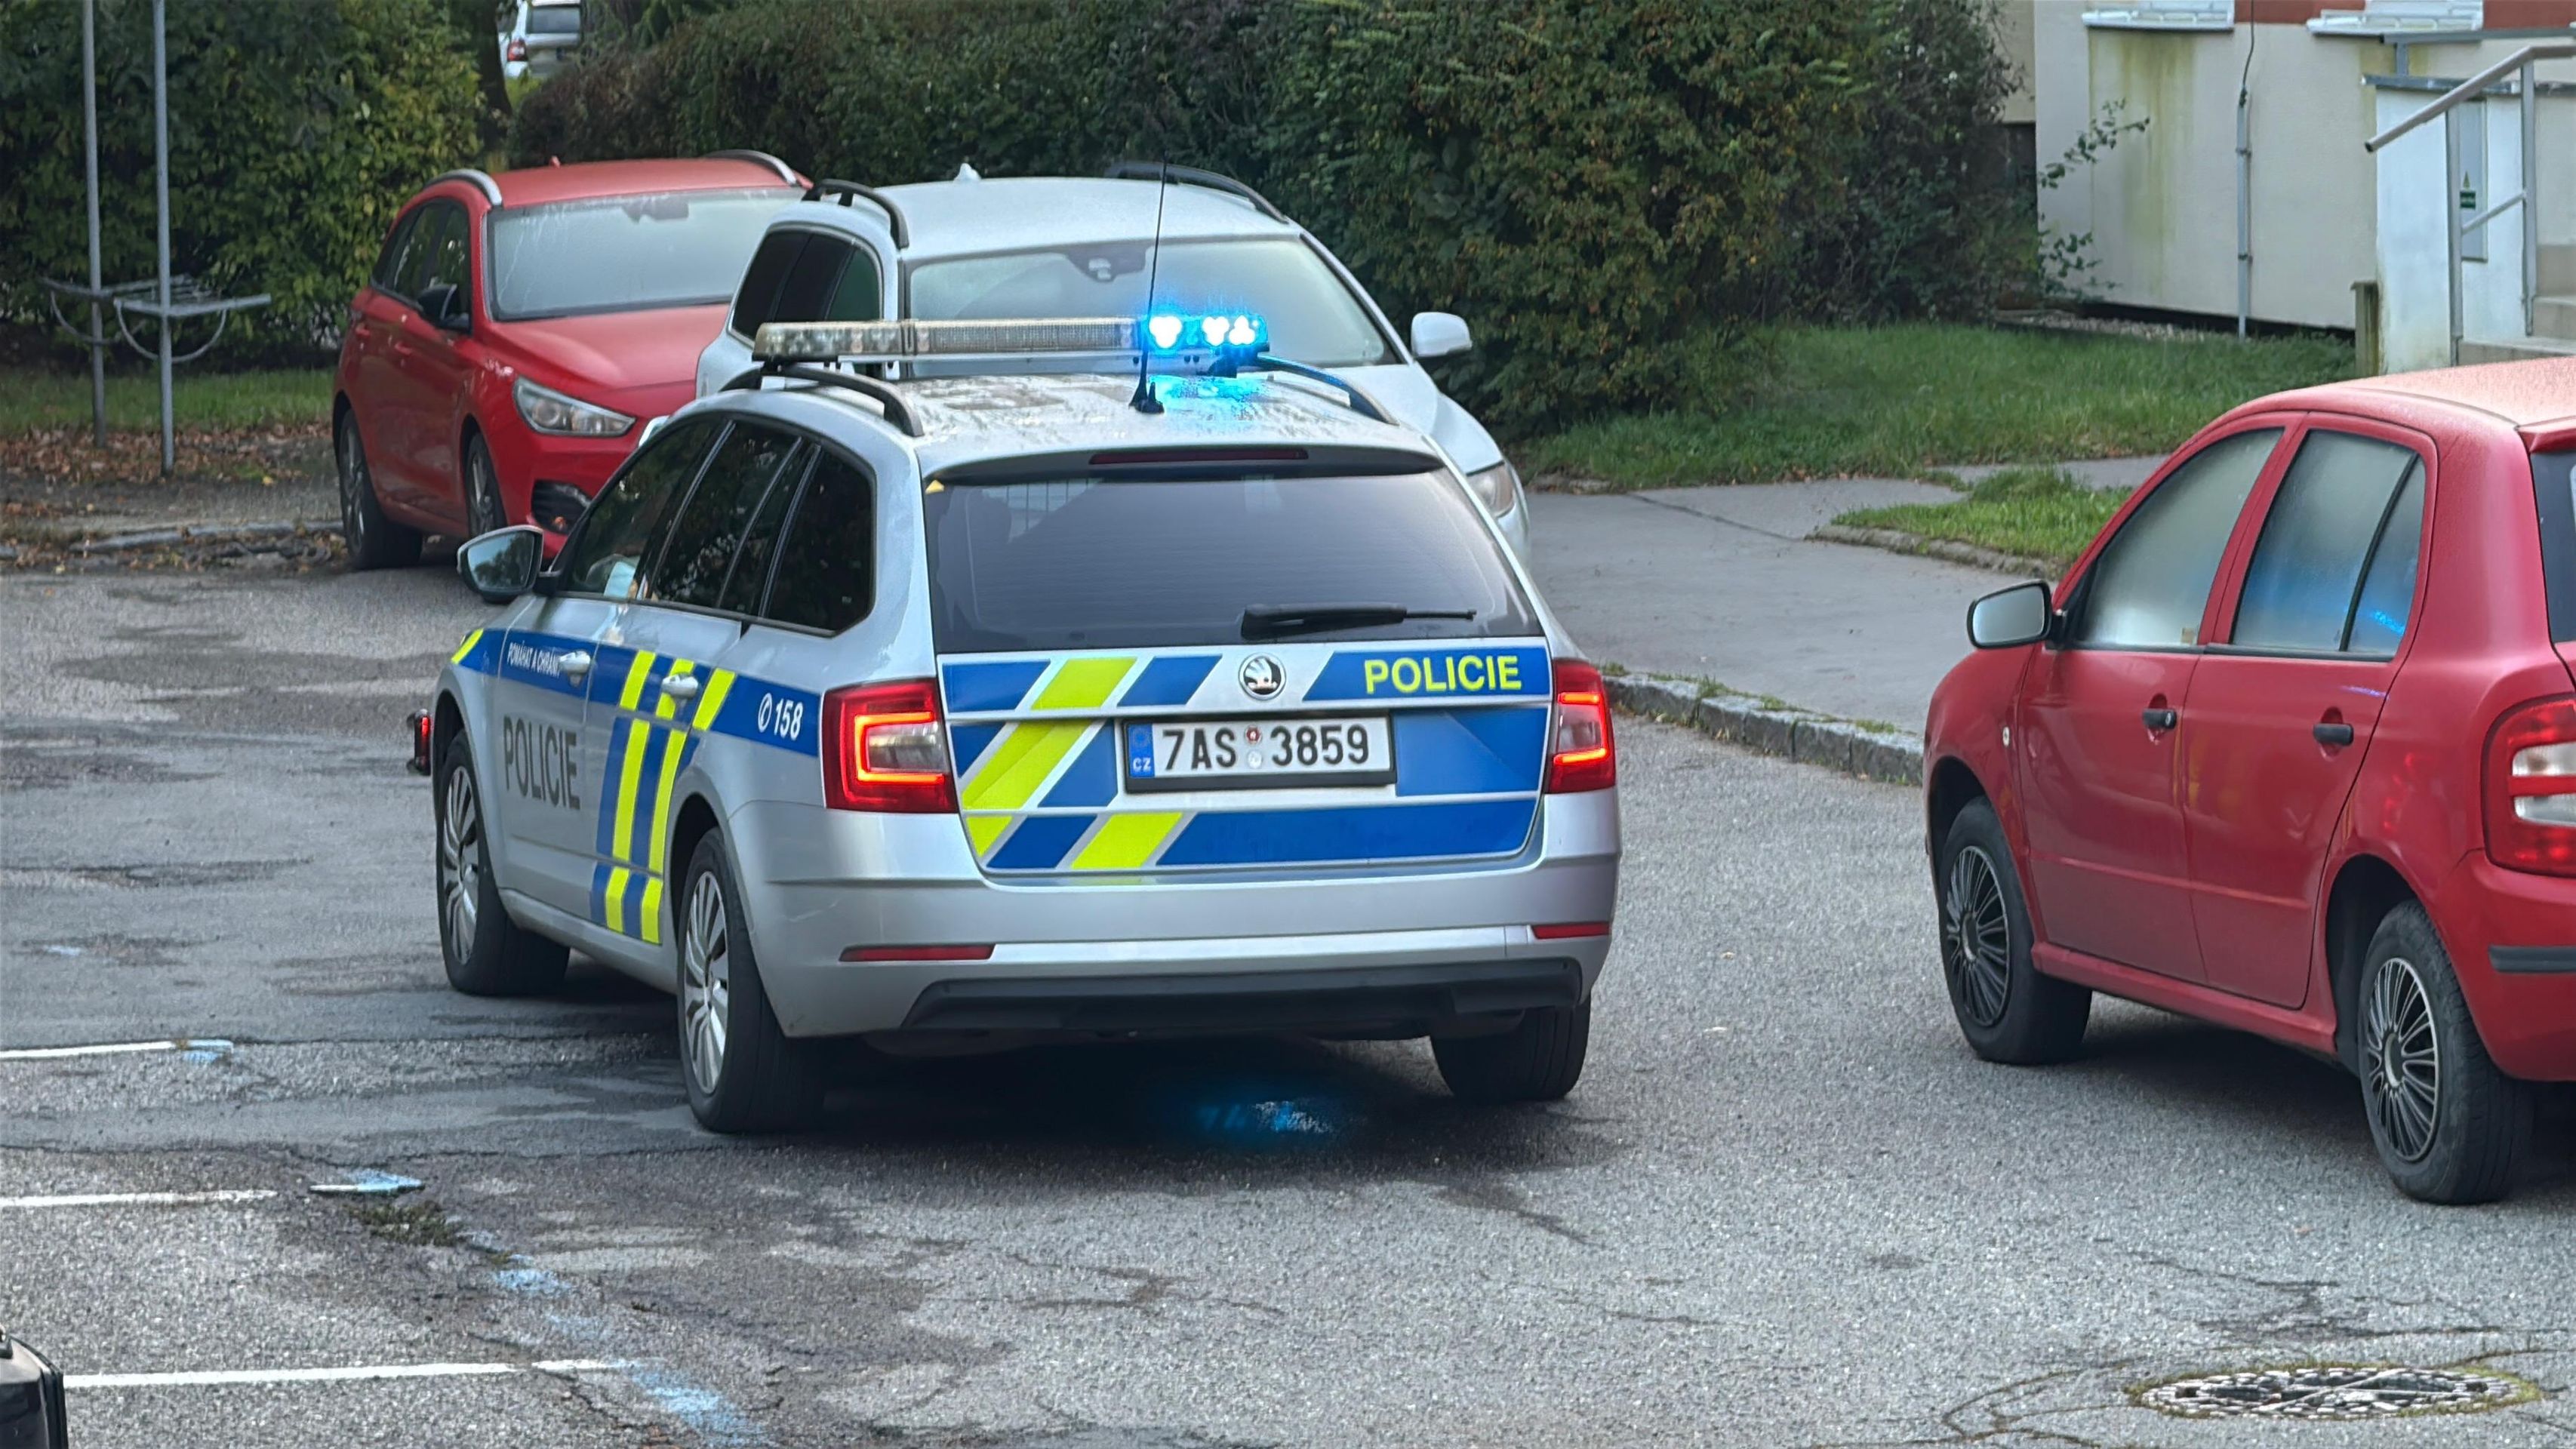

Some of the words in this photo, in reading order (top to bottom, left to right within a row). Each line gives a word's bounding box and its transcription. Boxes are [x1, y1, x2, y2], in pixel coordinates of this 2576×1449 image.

[531, 648, 538, 672] A
[1364, 655, 1522, 694] POLICIE
[774, 698, 803, 740] 158
[503, 714, 580, 810] POLICIE
[1133, 757, 1152, 772] CZ
[1162, 727, 1236, 771] 7AS
[1270, 724, 1369, 767] 3859
